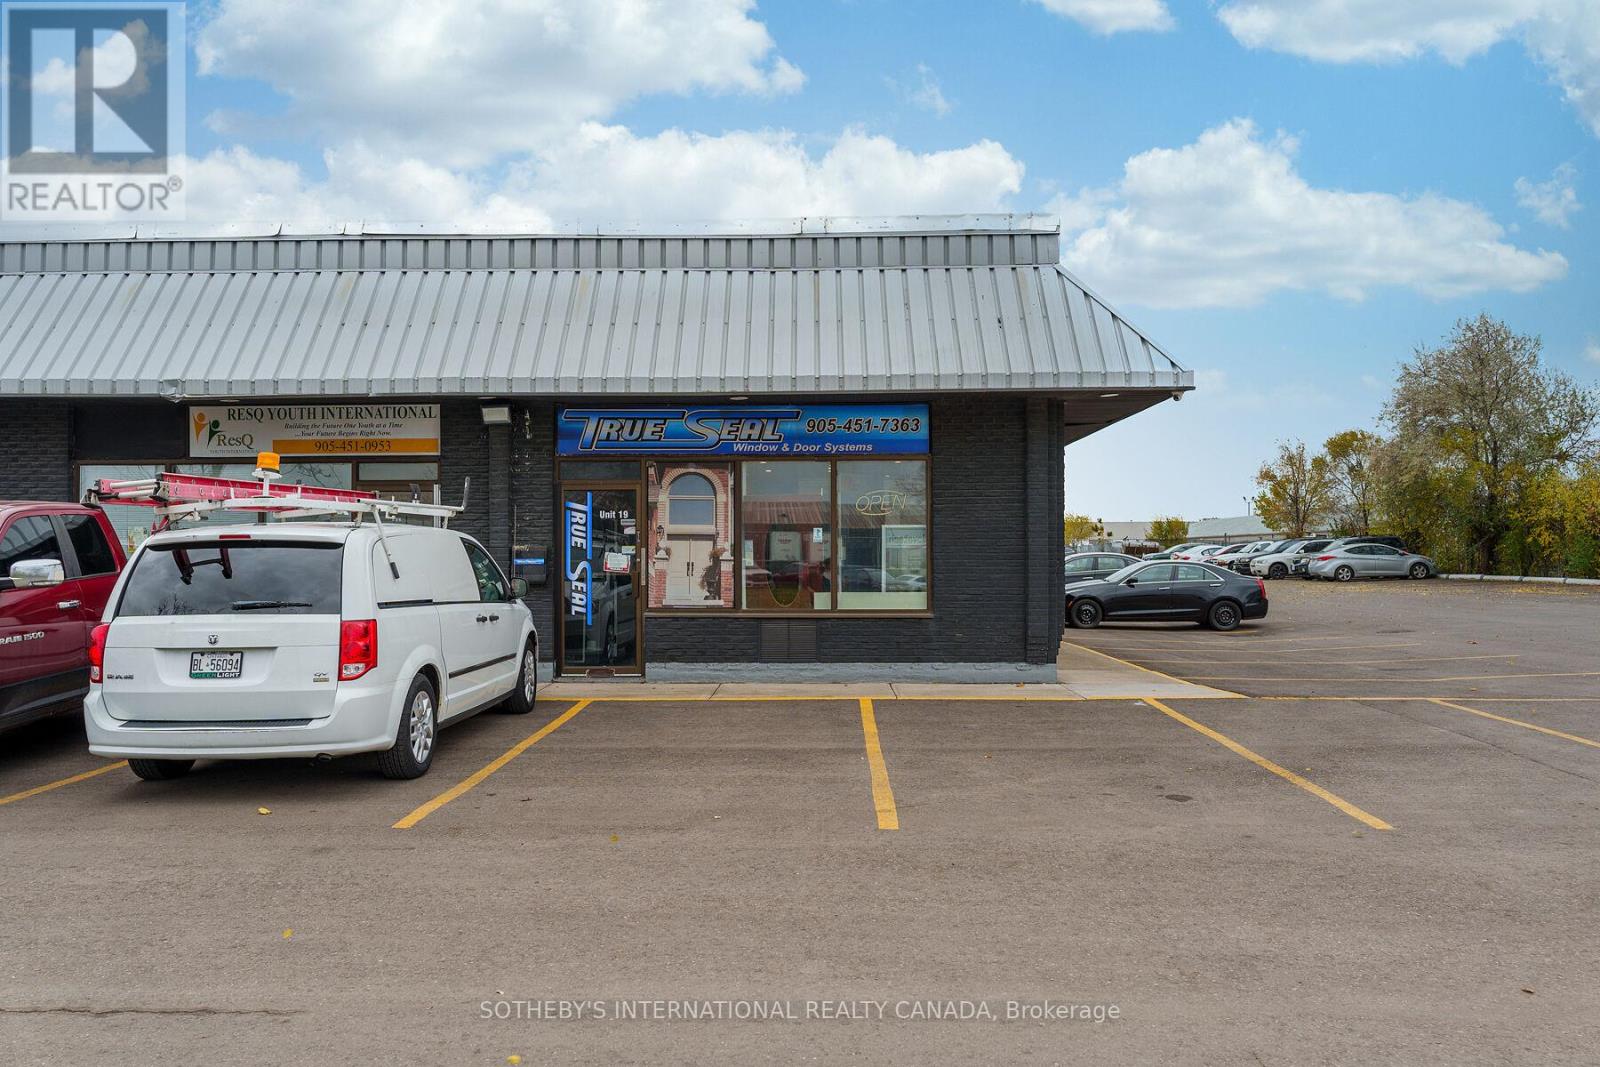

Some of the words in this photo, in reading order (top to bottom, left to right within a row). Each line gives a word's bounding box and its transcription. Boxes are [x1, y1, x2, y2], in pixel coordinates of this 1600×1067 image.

[227, 407, 264, 423] RESQ
[268, 407, 317, 420] YOUTH
[321, 406, 437, 420] INTERNATIONAL
[562, 409, 688, 450] TRUE
[683, 409, 802, 450] SEAL
[805, 417, 921, 434] 905-451-7363
[216, 434, 255, 449] ResQ
[338, 430, 359, 438] Begins
[360, 430, 376, 438] Right
[314, 440, 392, 452] 905-451-0953
[733, 442, 777, 453] Window
[782, 442, 790, 452] &
[792, 442, 819, 453] Door
[823, 441, 873, 454] Systems
[855, 494, 907, 512] OPEN
[600, 510, 616, 519] Unit
[618, 510, 629, 519] 19
[565, 492, 593, 560] TRUE
[566, 560, 593, 625] SEAL
[192, 659, 203, 671] BL
[210, 659, 239, 671] 56094
